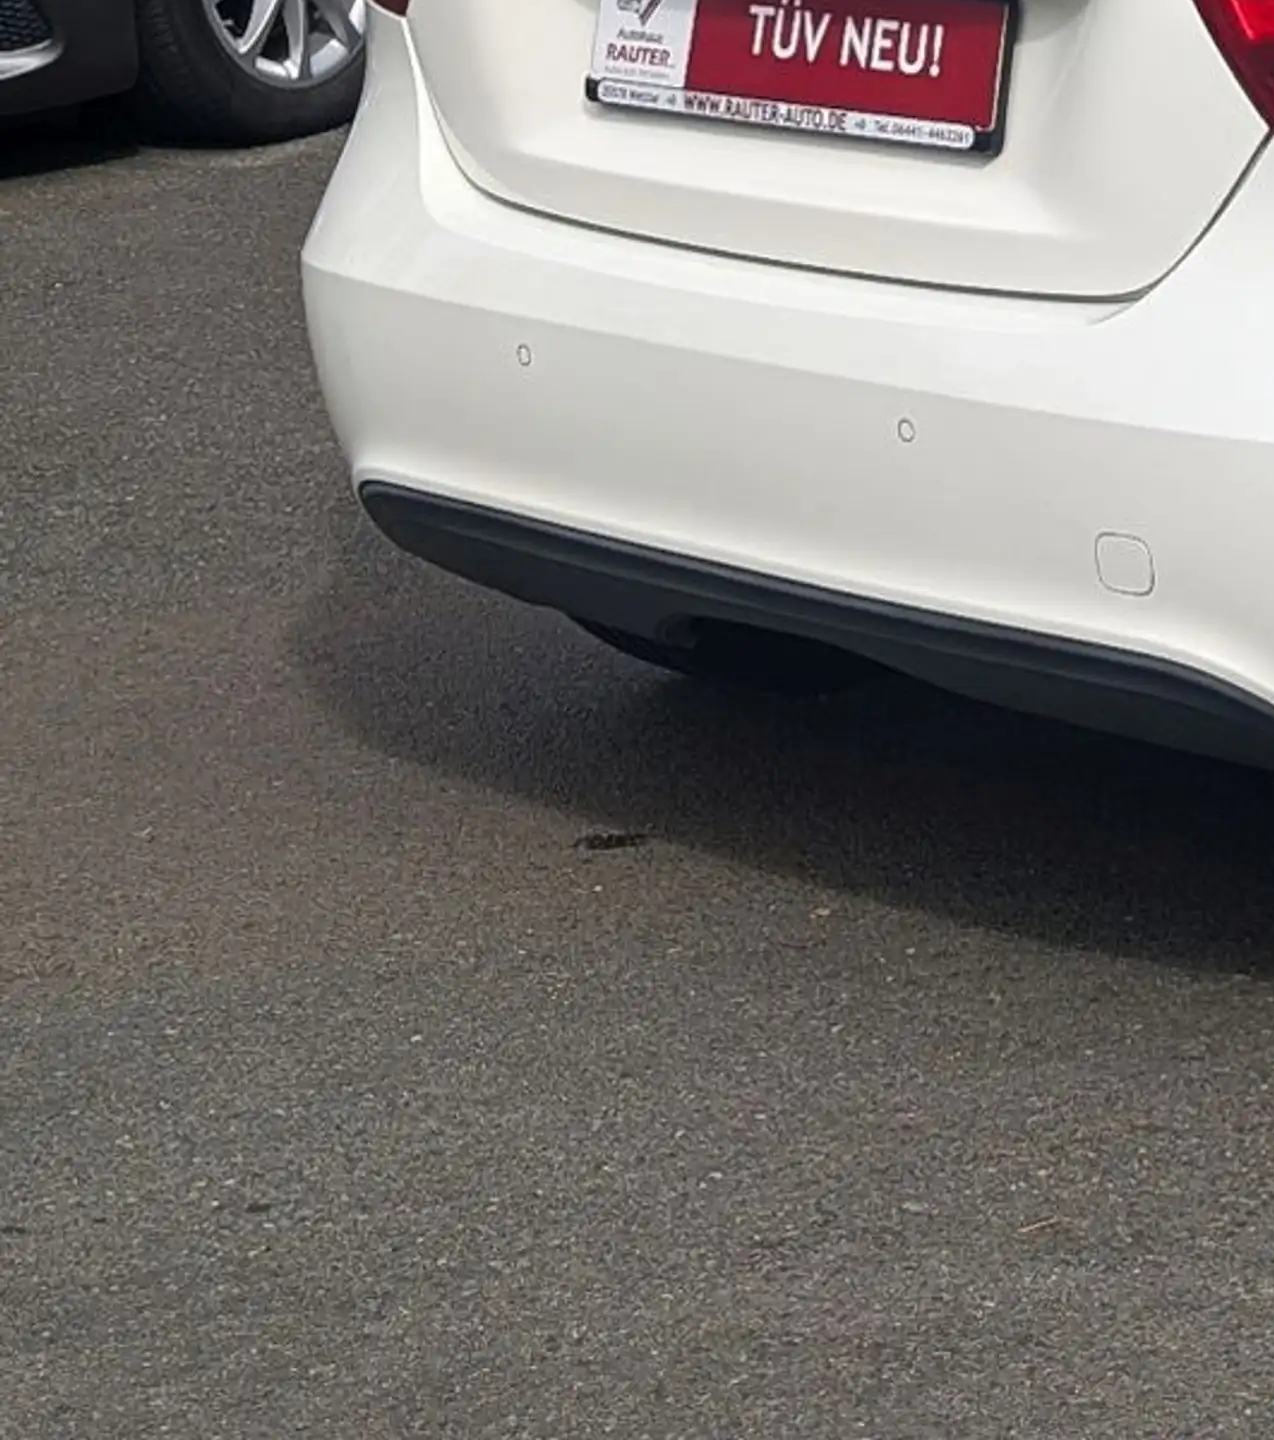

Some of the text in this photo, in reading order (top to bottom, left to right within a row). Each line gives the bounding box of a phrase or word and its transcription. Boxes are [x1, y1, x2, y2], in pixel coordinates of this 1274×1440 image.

[605, 42, 672, 68] RAUTER
[840, 17, 943, 78] NEU!
[683, 93, 848, 132] WWW.RAUTER-AUTO.DE
